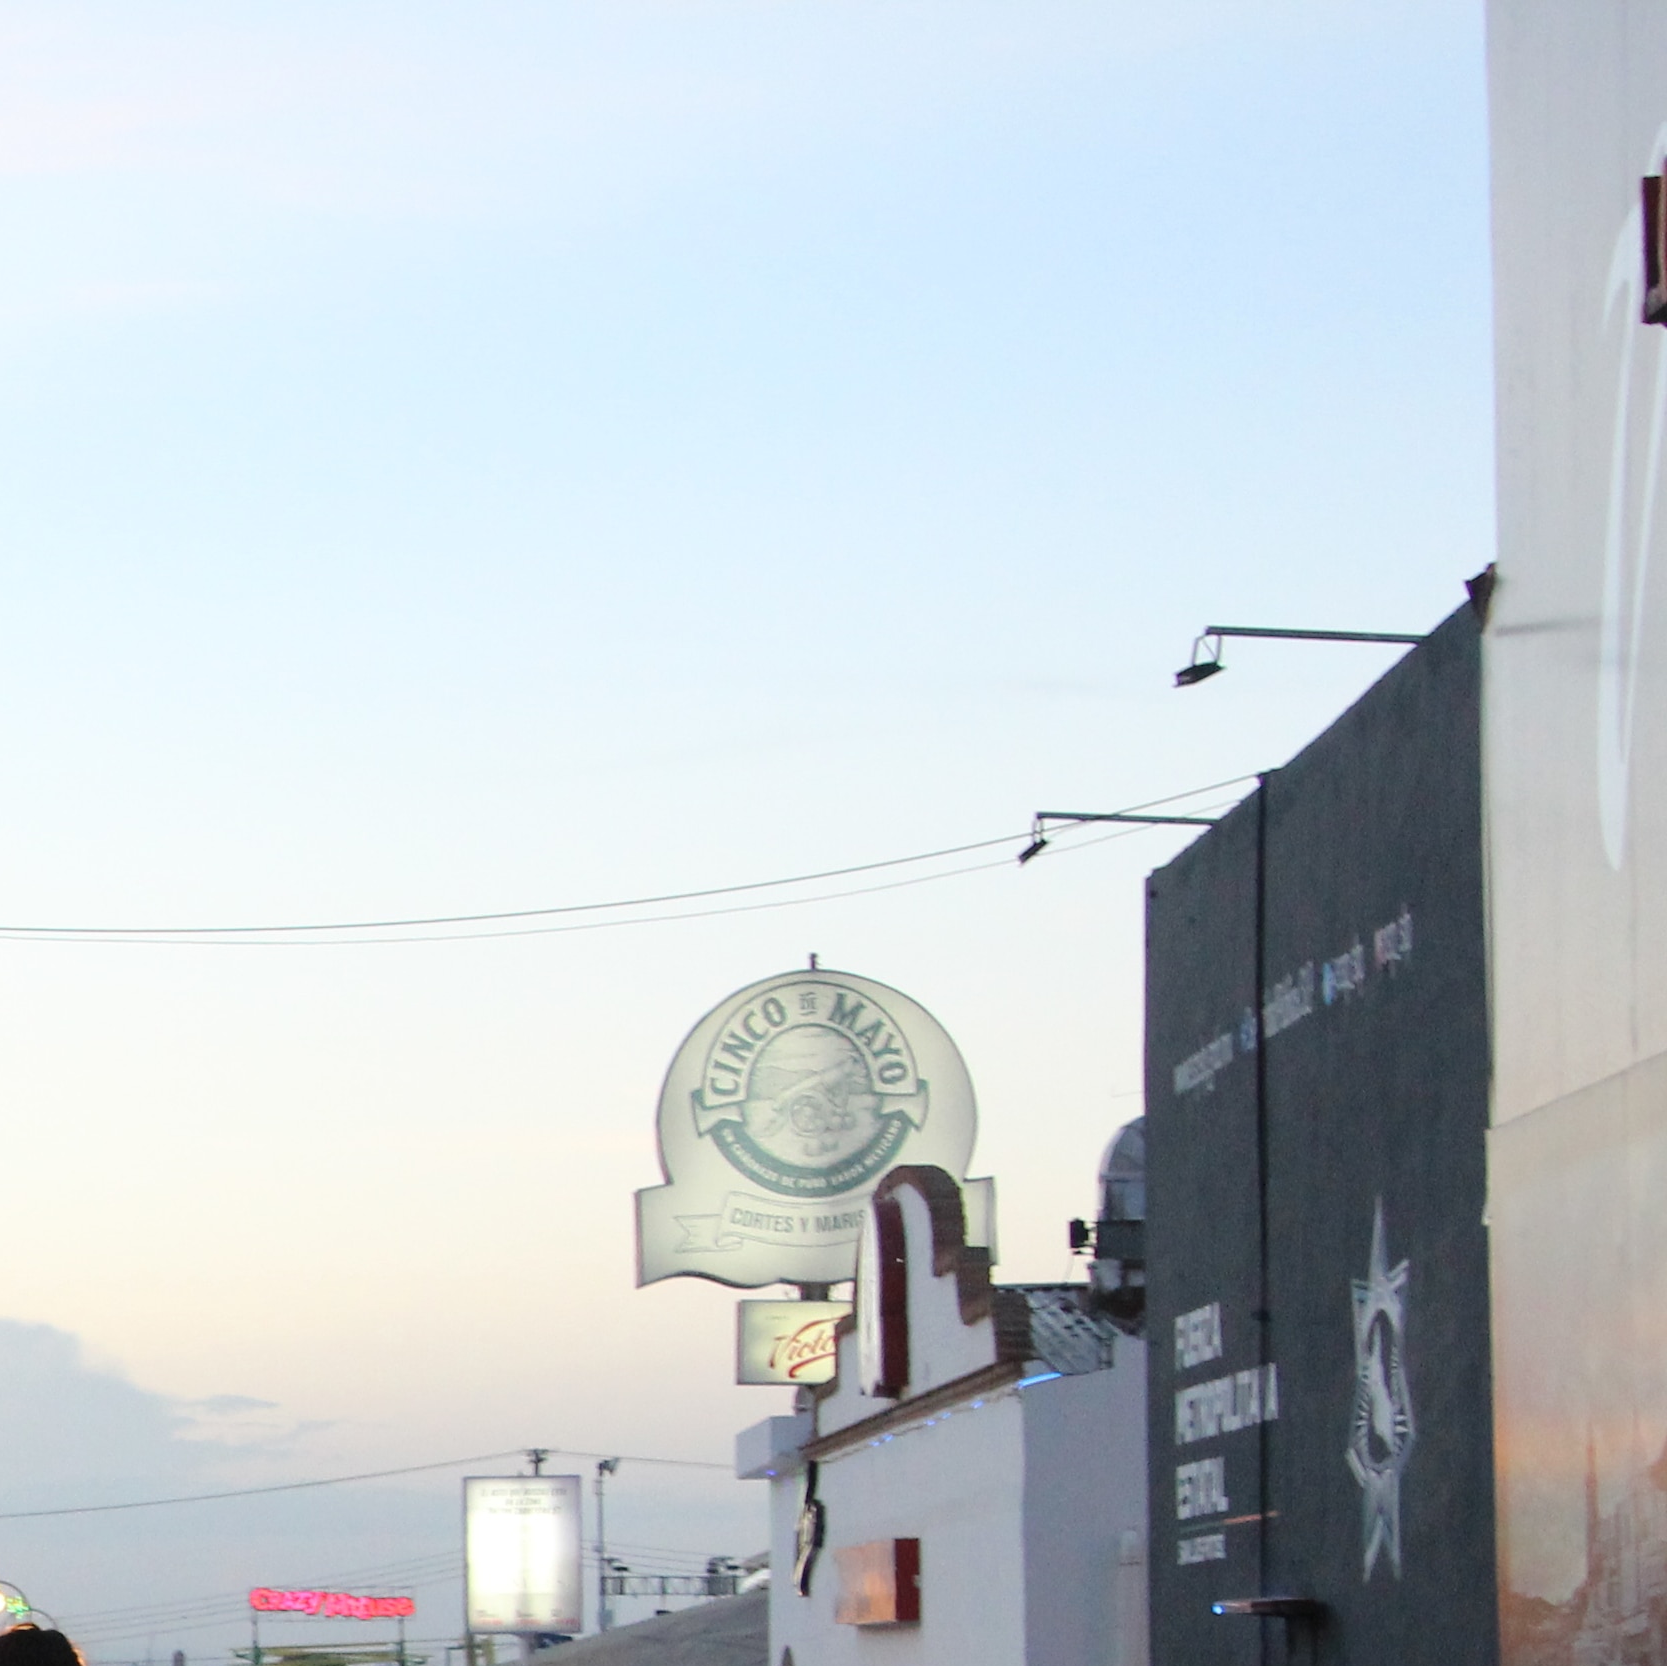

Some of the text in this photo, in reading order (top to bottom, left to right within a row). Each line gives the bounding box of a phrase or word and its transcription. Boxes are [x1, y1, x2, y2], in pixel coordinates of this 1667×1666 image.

[710, 997, 787, 1096] CINCO
[827, 993, 909, 1085] MAYO
[729, 1207, 794, 1234] CORTES
[799, 1217, 811, 1233] Y
